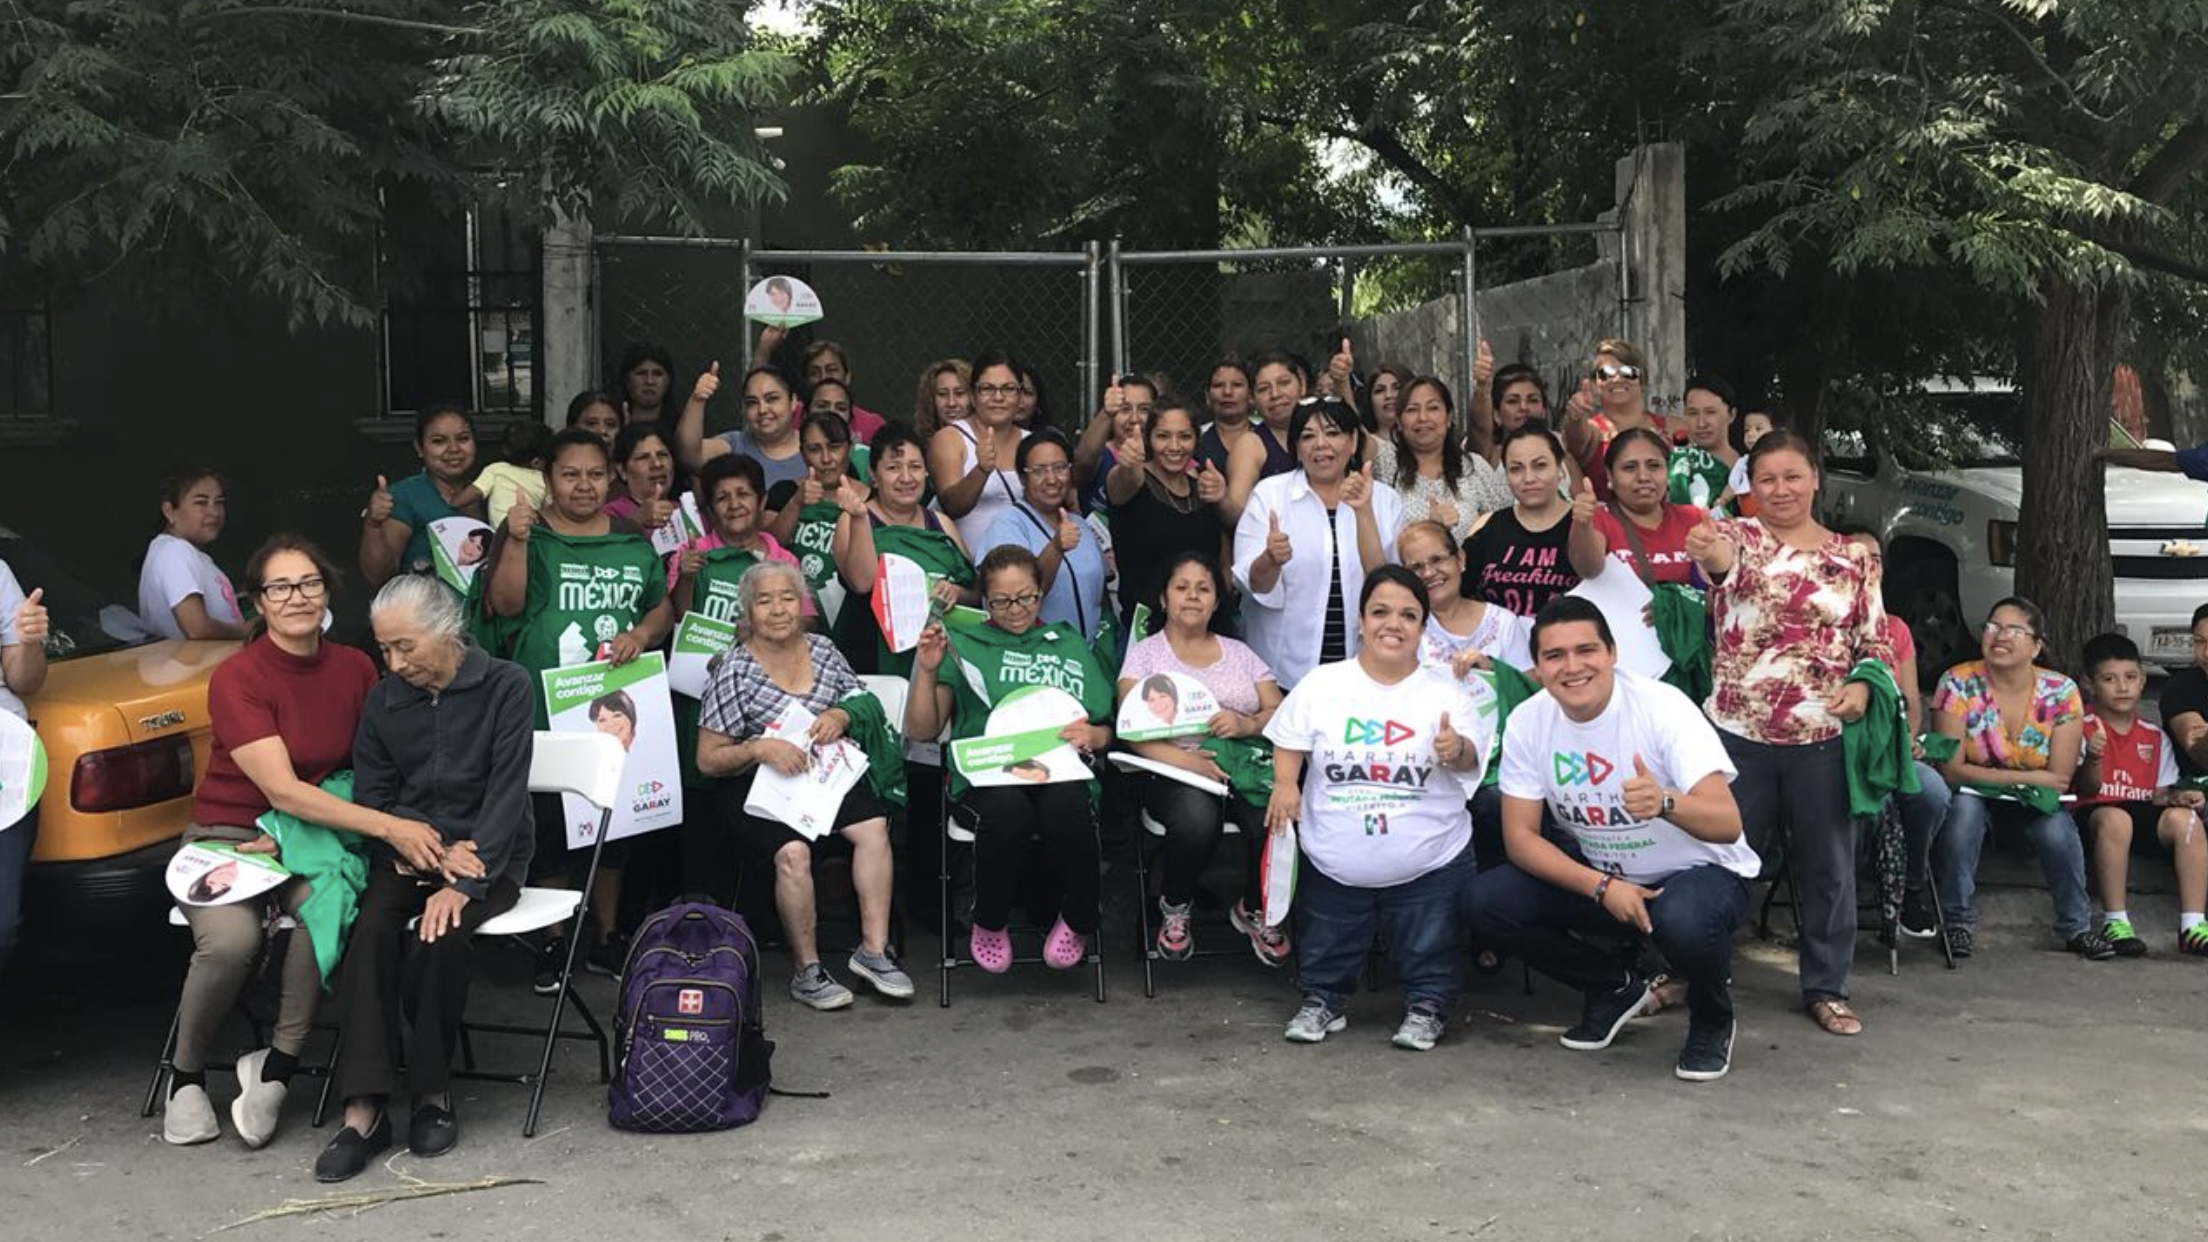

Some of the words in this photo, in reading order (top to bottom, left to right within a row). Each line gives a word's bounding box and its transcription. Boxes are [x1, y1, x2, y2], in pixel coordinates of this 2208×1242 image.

[1502, 546, 1515, 564] I
[1519, 547, 1558, 567] AM
[1615, 549, 1692, 565] TAM
[555, 672, 605, 688] Avanzar
[556, 683, 604, 699] contigo
[966, 743, 1015, 756] Avanzar
[1323, 750, 1433, 764] MARTHA
[966, 753, 1015, 767] contigo
[1325, 763, 1432, 787] GARAY
[633, 797, 671, 813] GARAY
[1551, 791, 1620, 804] ARTH
[1556, 802, 1642, 827] GARA
